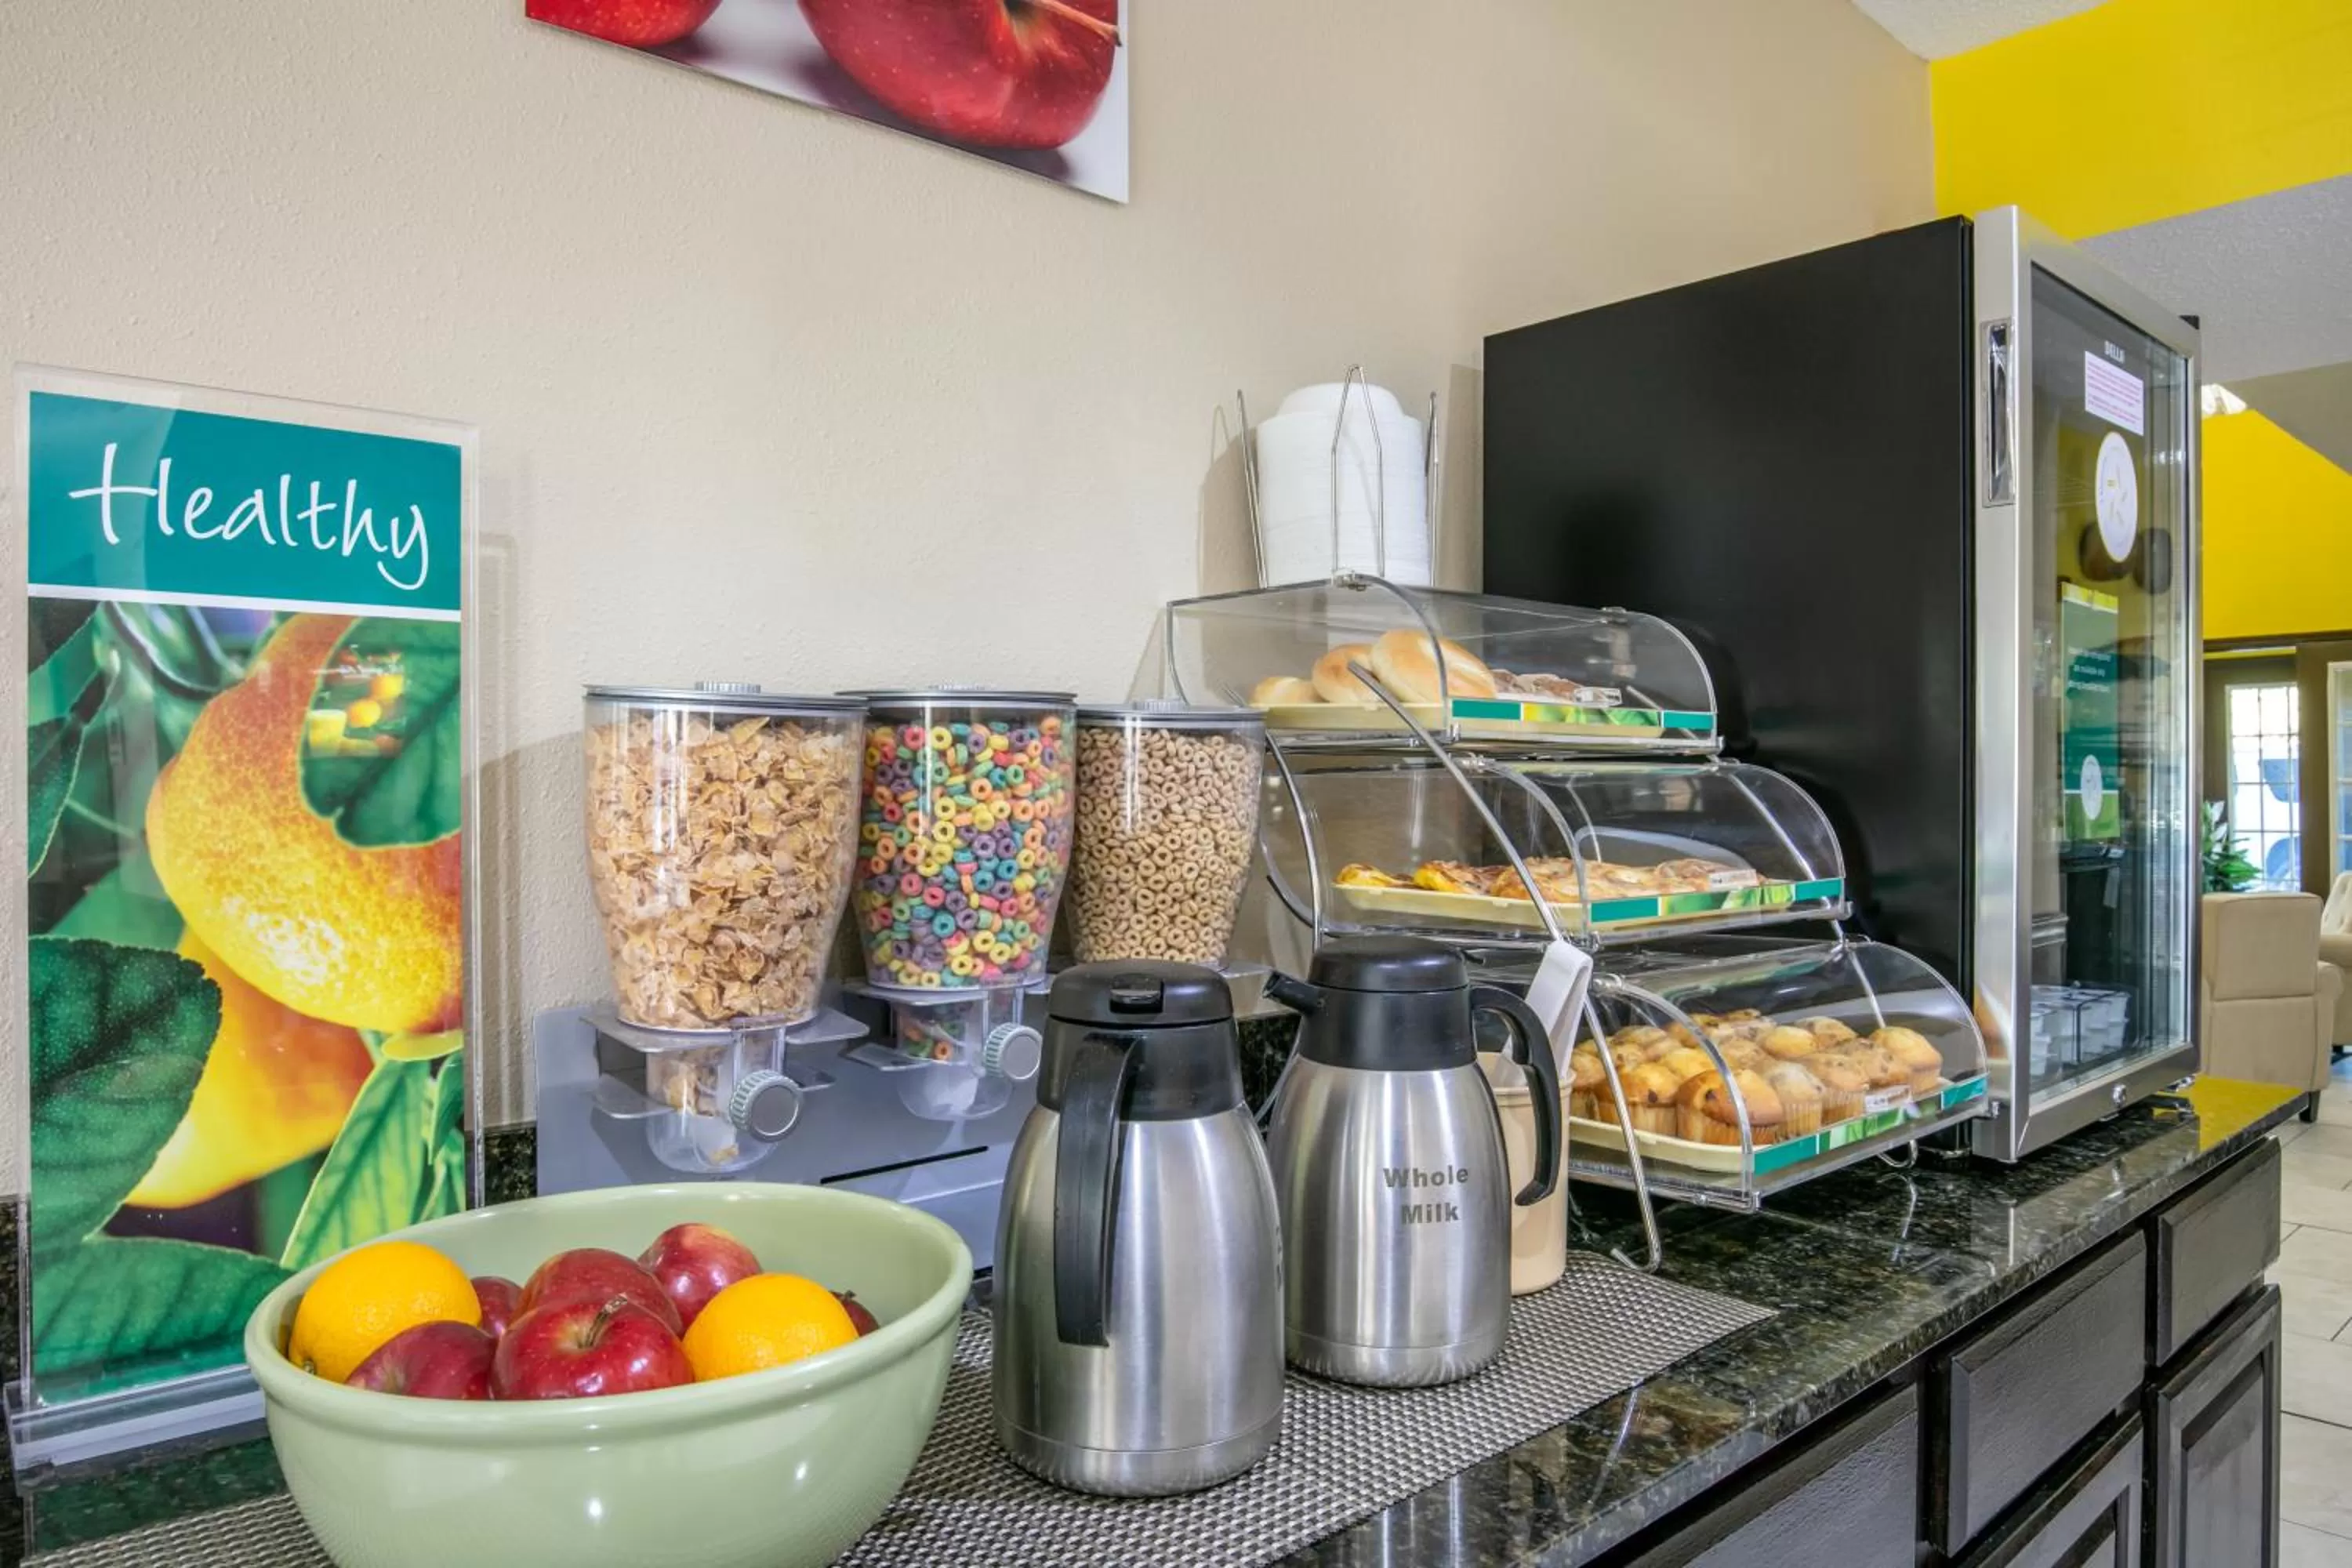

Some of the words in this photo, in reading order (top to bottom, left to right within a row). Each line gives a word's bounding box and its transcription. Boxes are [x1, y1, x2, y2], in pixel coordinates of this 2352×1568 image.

[69, 442, 428, 590] Healthy
[1382, 1165, 1468, 1188] Whole
[1401, 1203, 1459, 1225] Milk
